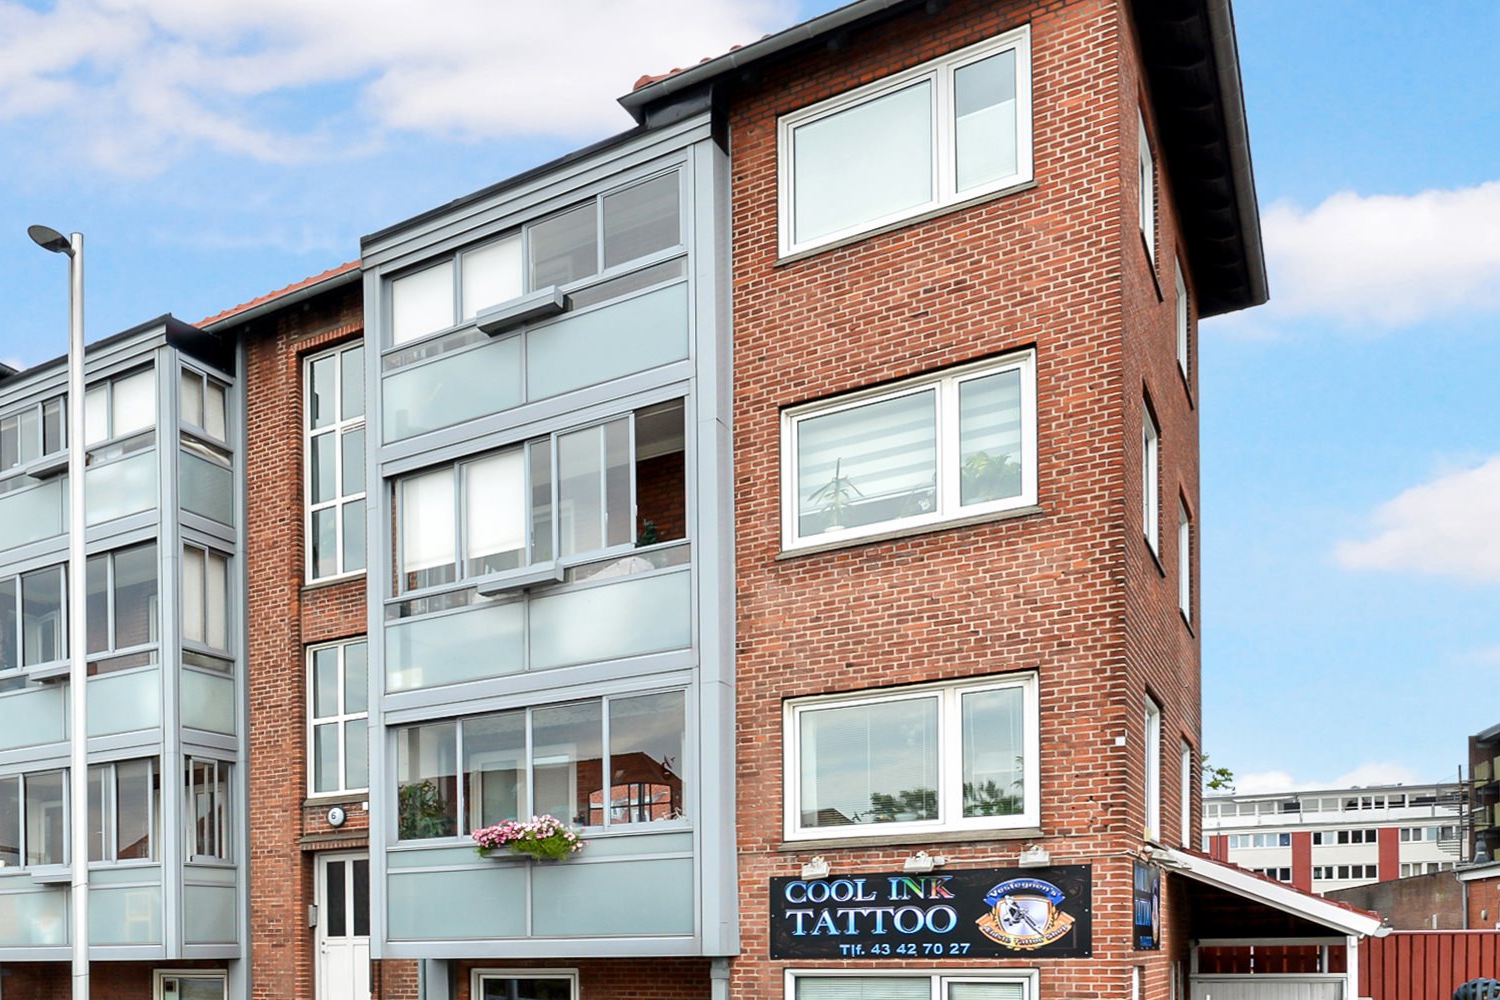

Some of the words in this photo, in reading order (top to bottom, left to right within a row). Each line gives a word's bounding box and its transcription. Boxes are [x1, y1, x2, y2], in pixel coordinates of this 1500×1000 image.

[331, 812, 336, 820] 6
[785, 879, 876, 903] COOL
[887, 875, 955, 900] INK
[785, 905, 957, 935] TATTOO
[1014, 937, 1044, 945] Tattoo
[839, 943, 866, 956] Tlf.
[871, 943, 891, 955] 43
[896, 943, 917, 955] 42
[922, 943, 943, 955] 70
[949, 943, 971, 955] 27
